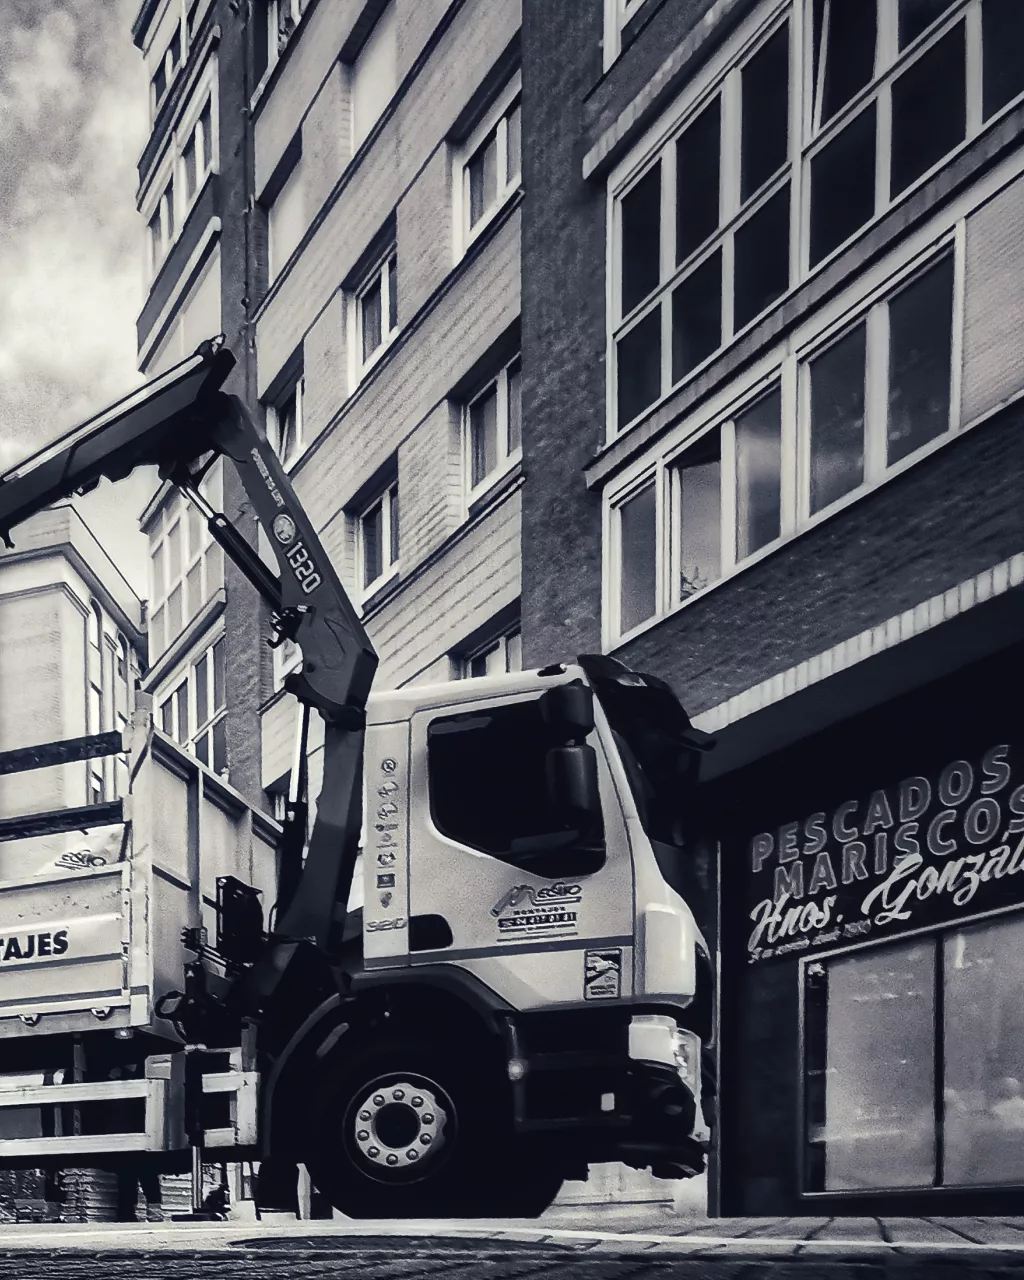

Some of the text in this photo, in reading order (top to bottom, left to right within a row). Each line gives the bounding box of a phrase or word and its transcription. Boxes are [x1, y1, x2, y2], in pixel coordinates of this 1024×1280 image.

[286, 541, 322, 594] 1320
[751, 744, 1011, 872] PESCADOS
[747, 894, 844, 952] Hnos.
[860, 831, 1024, 926] Gonzál
